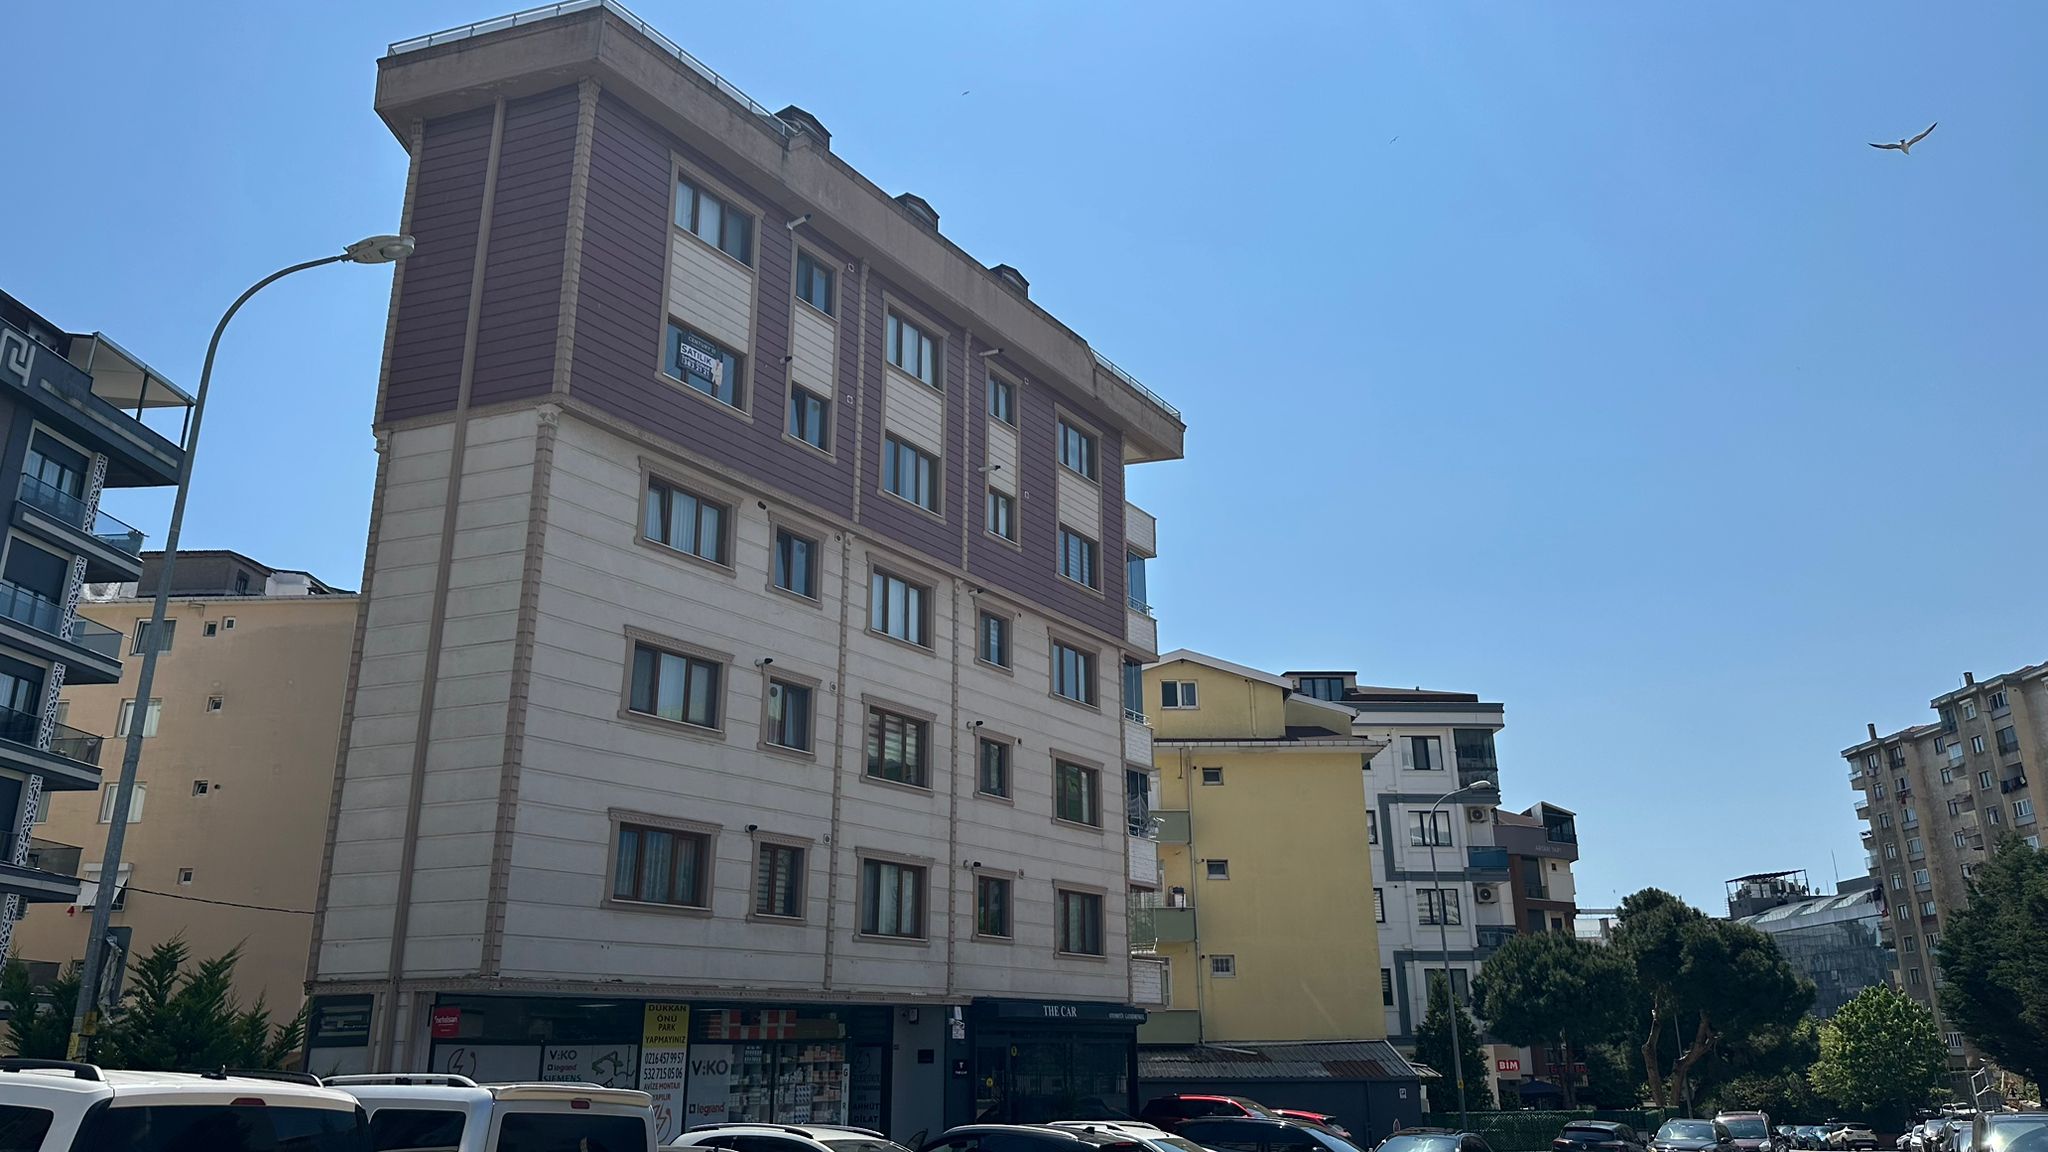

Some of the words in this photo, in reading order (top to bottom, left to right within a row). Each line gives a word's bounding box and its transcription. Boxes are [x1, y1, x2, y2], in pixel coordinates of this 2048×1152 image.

[681, 344, 712, 366] SATILIK
[1043, 1005, 1060, 1017] THE
[1060, 1005, 1077, 1017] CAR
[658, 1023, 676, 1032] PARK
[645, 1036, 686, 1044] YAPMAYINIZ
[543, 1074, 582, 1082] SIEMENS
[697, 1102, 727, 1117] legrand
